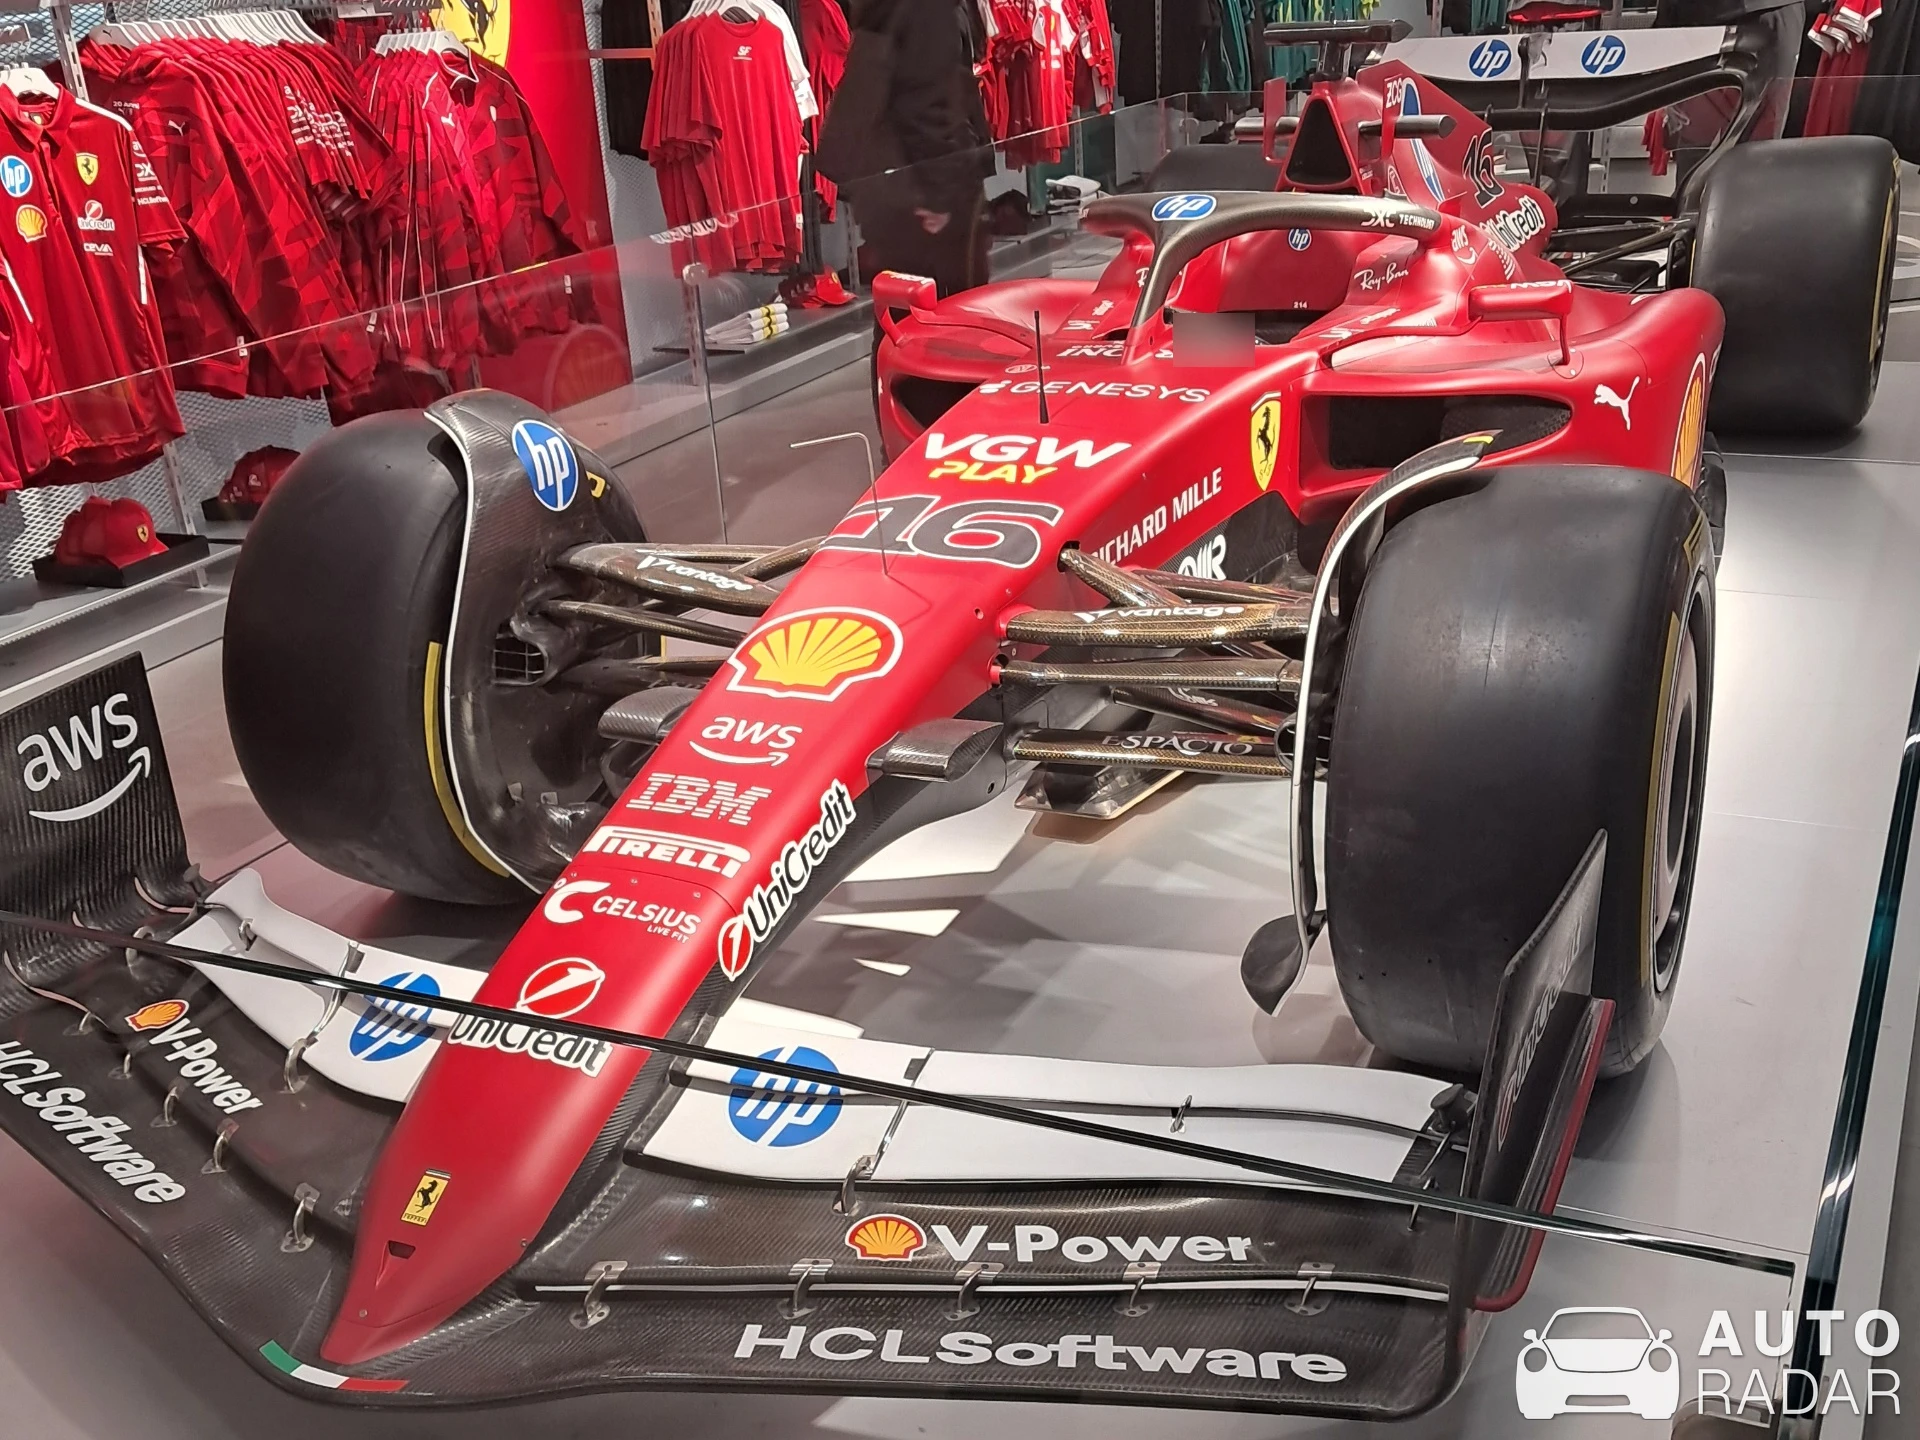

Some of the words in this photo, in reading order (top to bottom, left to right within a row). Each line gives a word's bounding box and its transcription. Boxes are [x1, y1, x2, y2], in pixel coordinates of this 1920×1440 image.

[1472, 39, 1510, 78] hp
[1585, 35, 1624, 75] hp
[1, 156, 29, 196] hp
[1463, 127, 1504, 209] 16
[1157, 195, 1212, 219] hp
[1290, 229, 1310, 250] hp
[1354, 262, 1409, 290] Ray-Ban
[1010, 381, 1210, 404] GENESYS
[515, 419, 571, 510] hp
[925, 433, 1132, 469] VGW
[929, 461, 1058, 485] PLAY
[1172, 467, 1222, 522] MILLE
[819, 494, 1064, 570] 16
[666, 563, 754, 591] vantage
[1117, 605, 1245, 617] vantage
[17, 693, 138, 792] aws
[701, 716, 803, 750] aws
[626, 772, 773, 826] IBM
[582, 825, 751, 879] PIRELLI
[747, 784, 852, 938] UniCredit
[592, 895, 702, 936] CELSIUS
[646, 924, 671, 938] LIVE
[671, 930, 691, 944] FIT
[450, 1012, 607, 1072] UniCredit
[148, 1018, 263, 1114] V-Power
[0, 1040, 186, 1203] HCLSoftware
[931, 1224, 1253, 1262] V-Power
[734, 1325, 1347, 1382] HCLSoftware
